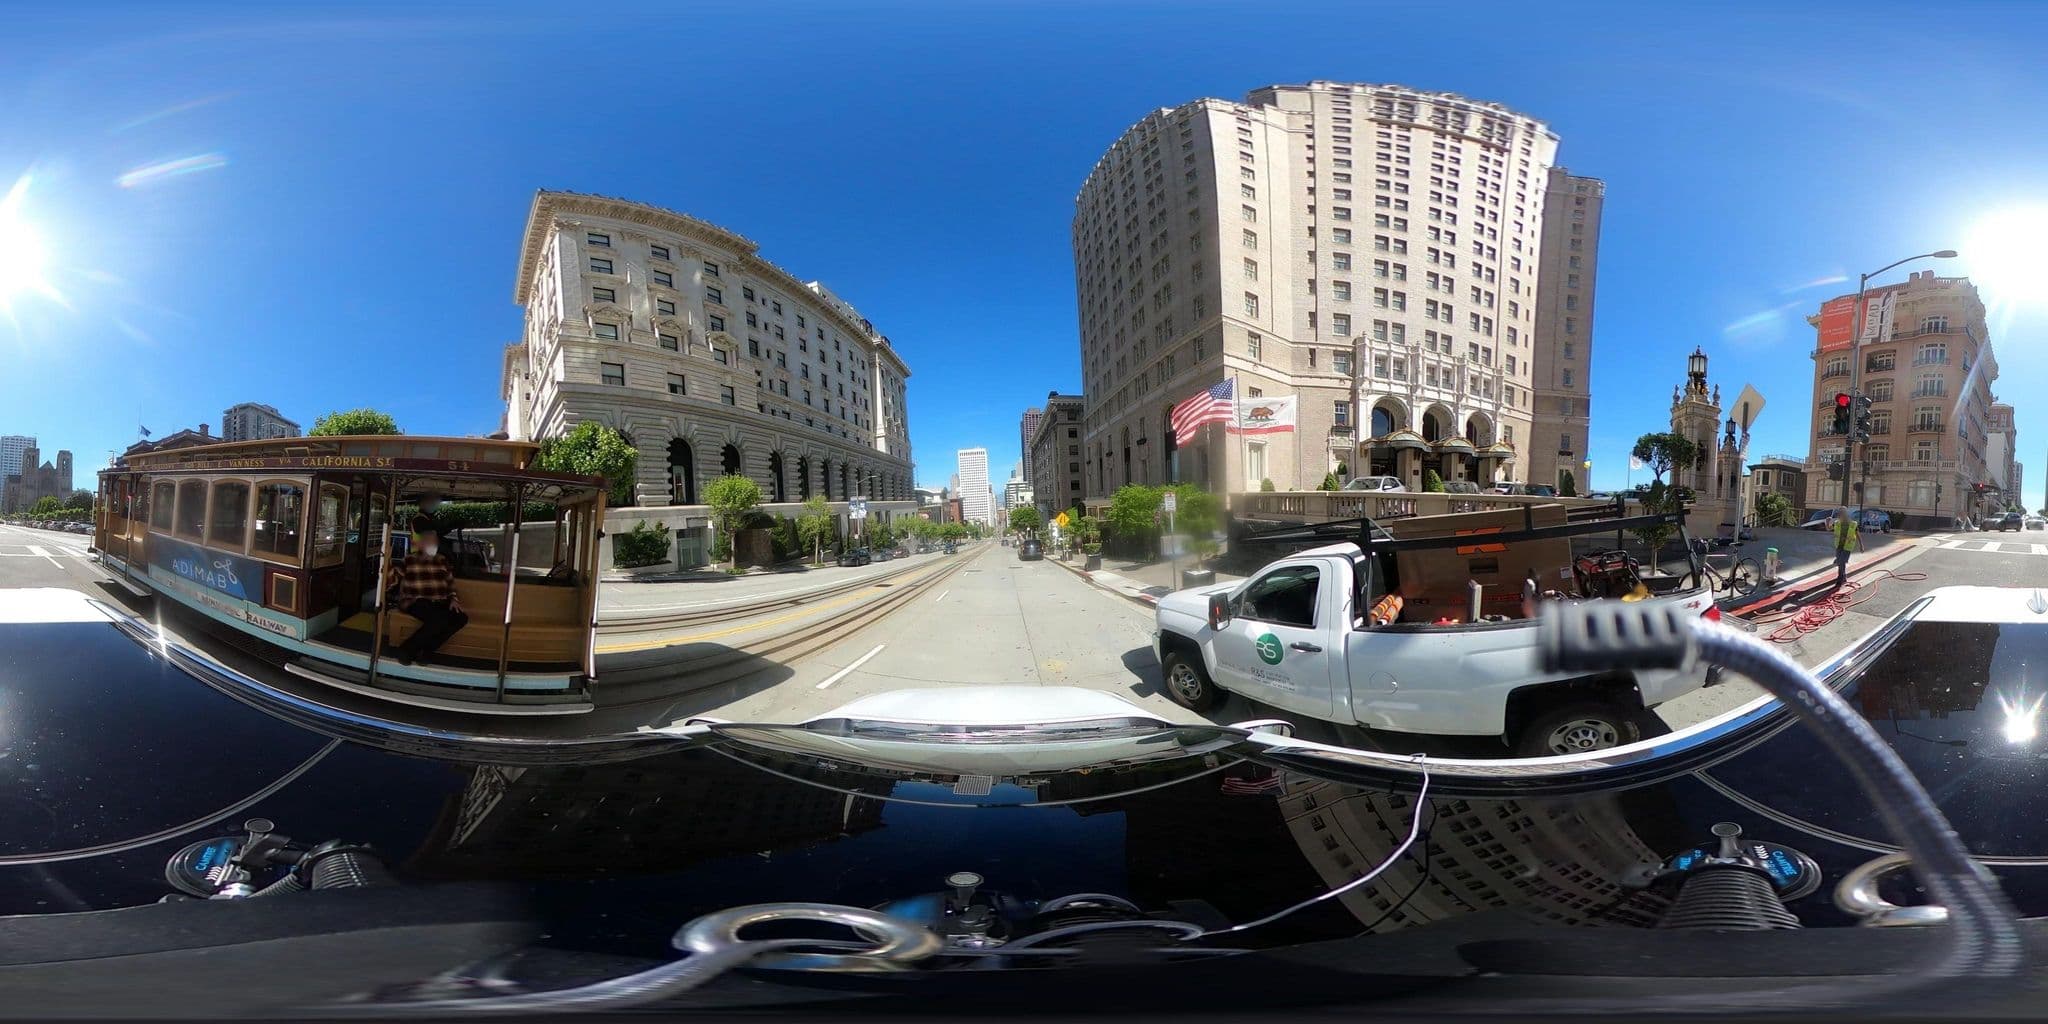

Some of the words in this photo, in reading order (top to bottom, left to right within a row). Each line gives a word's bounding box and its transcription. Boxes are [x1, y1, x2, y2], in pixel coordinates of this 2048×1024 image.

[244, 459, 265, 467] NESS
[302, 457, 371, 467] CALIFORNIA
[172, 559, 226, 588] ADIMAB
[247, 612, 287, 633] RAILWAY
